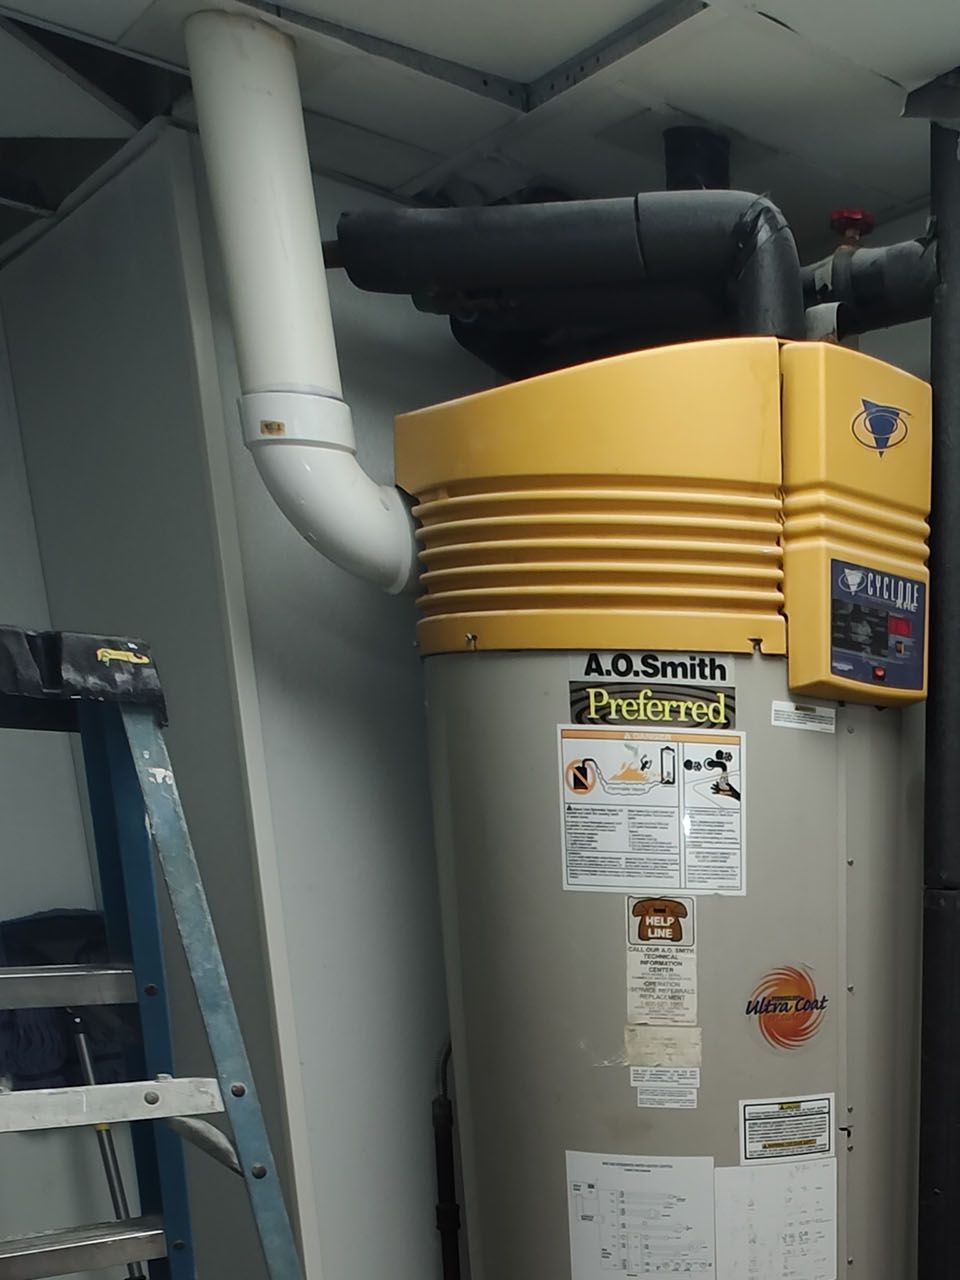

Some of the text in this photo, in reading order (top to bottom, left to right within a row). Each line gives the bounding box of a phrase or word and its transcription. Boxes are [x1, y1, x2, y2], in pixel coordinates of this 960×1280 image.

[867, 572, 919, 606] CYCLONE
[586, 688, 728, 724] Preferred
[646, 916, 675, 926] HELP
[648, 928, 673, 938] LINE
[745, 995, 829, 1015] Ultra Coat
